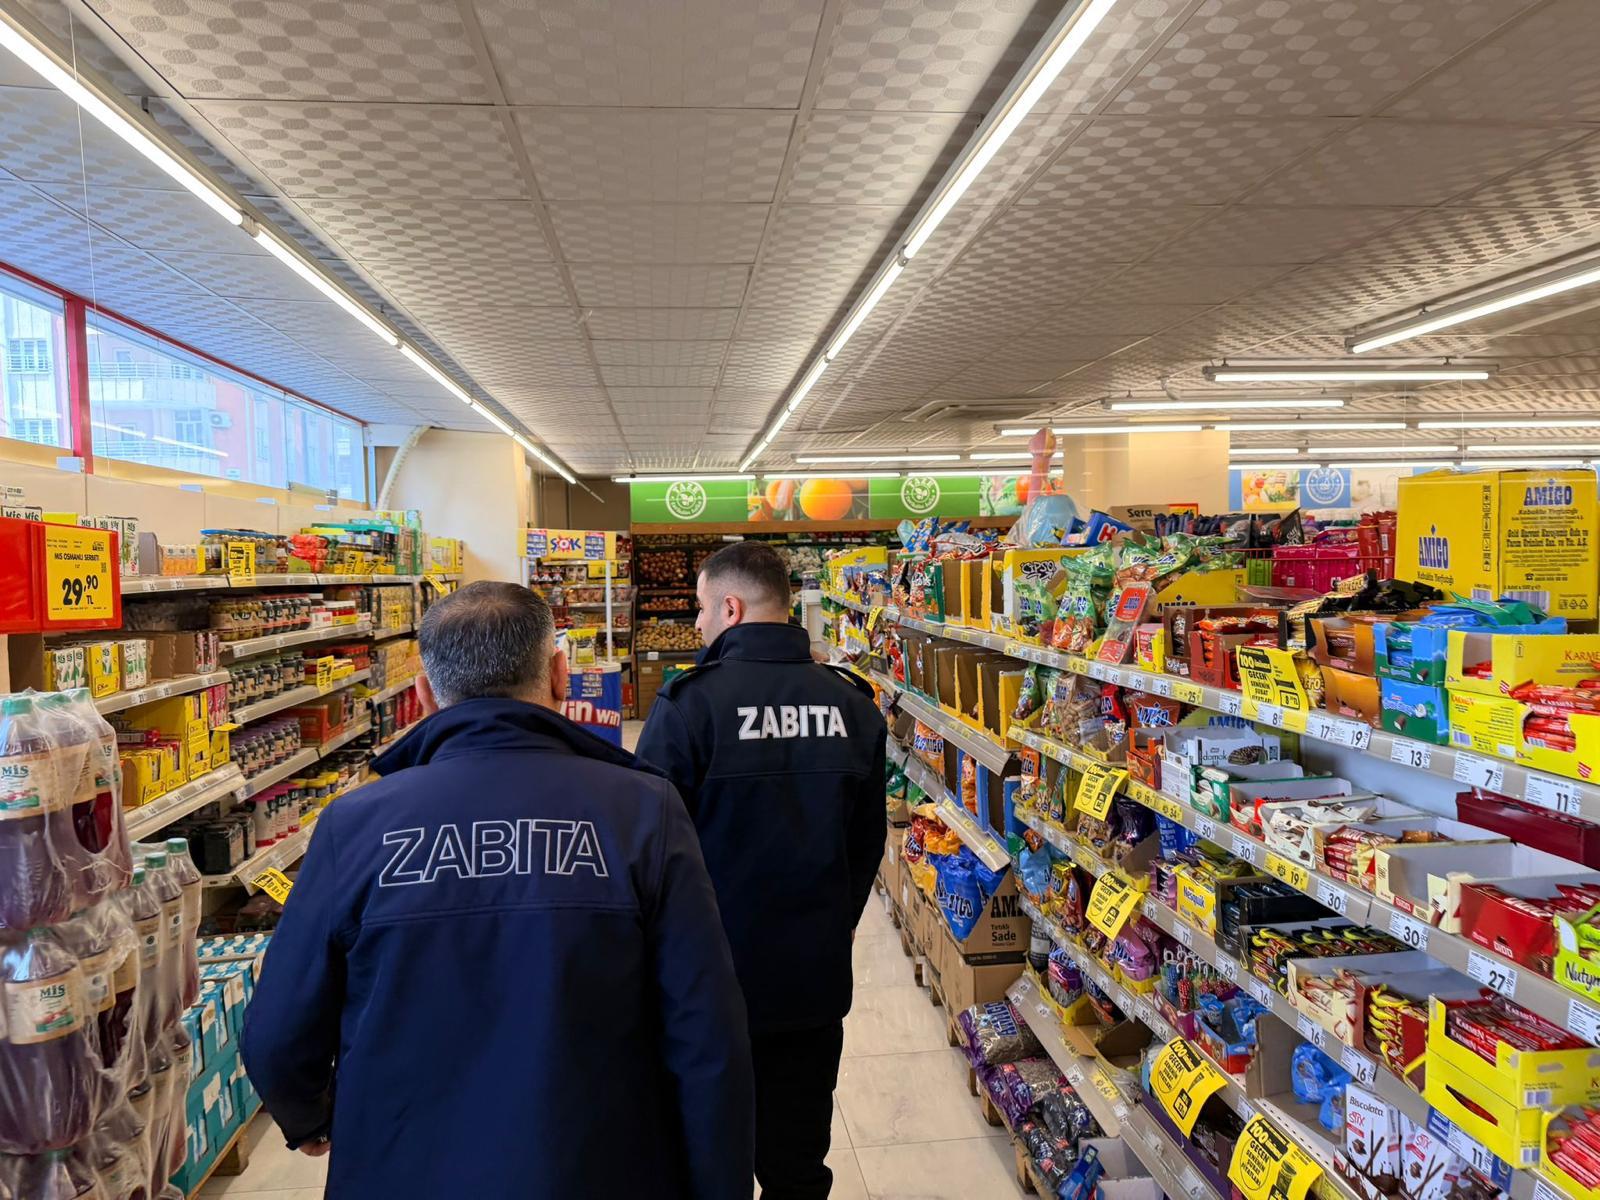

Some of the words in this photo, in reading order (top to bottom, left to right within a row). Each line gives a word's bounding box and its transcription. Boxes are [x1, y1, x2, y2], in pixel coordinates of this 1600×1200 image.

[1127, 508, 1153, 518] Sera
[86, 595, 94, 605] TL
[596, 709, 620, 727] win
[737, 706, 848, 740] ZABITA
[1320, 725, 1331, 740] 17
[1351, 731, 1363, 746] 19
[1410, 750, 1422, 766] 13
[1485, 769, 1494, 787] 7
[1556, 792, 1569, 812] 11
[1202, 825, 1212, 838] 50
[379, 819, 609, 887] ZABITA
[1240, 846, 1251, 860] 30
[1327, 893, 1341, 911] 30
[991, 931, 1016, 942] Sade
[1403, 926, 1420, 947] 30
[1488, 970, 1506, 991] 27
[1311, 1028, 1320, 1045] 16
[1171, 1040, 1188, 1058] 100
[1357, 1062, 1367, 1081] 16
[1349, 1096, 1384, 1117] Biscolata
[1249, 1122, 1269, 1144] 100
[1472, 1147, 1483, 1168] 11
